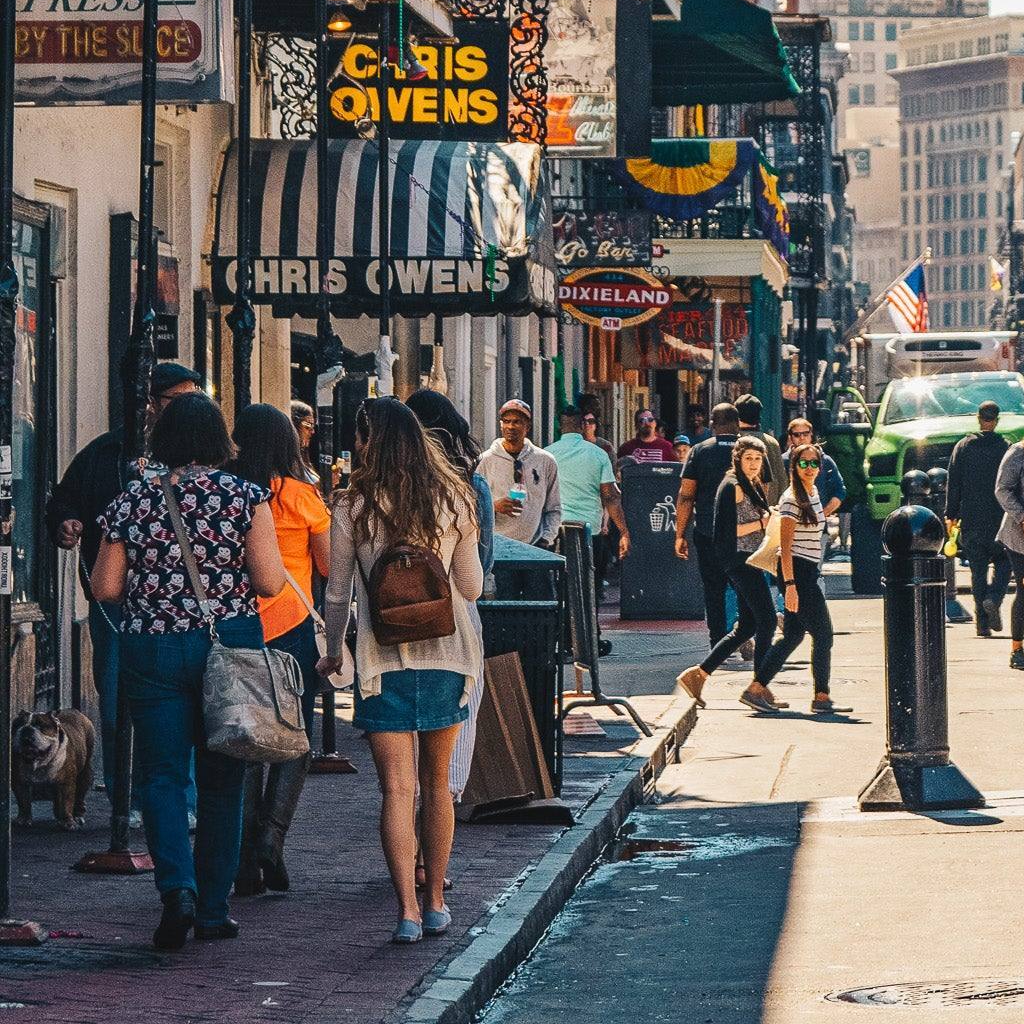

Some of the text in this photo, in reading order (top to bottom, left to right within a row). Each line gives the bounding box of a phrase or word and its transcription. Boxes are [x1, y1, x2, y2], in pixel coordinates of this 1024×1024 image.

[57, 25, 108, 58] THE
[116, 25, 190, 59] SLCE
[560, 286, 670, 304] DIXIELAND
[602, 319, 620, 328] ATM
